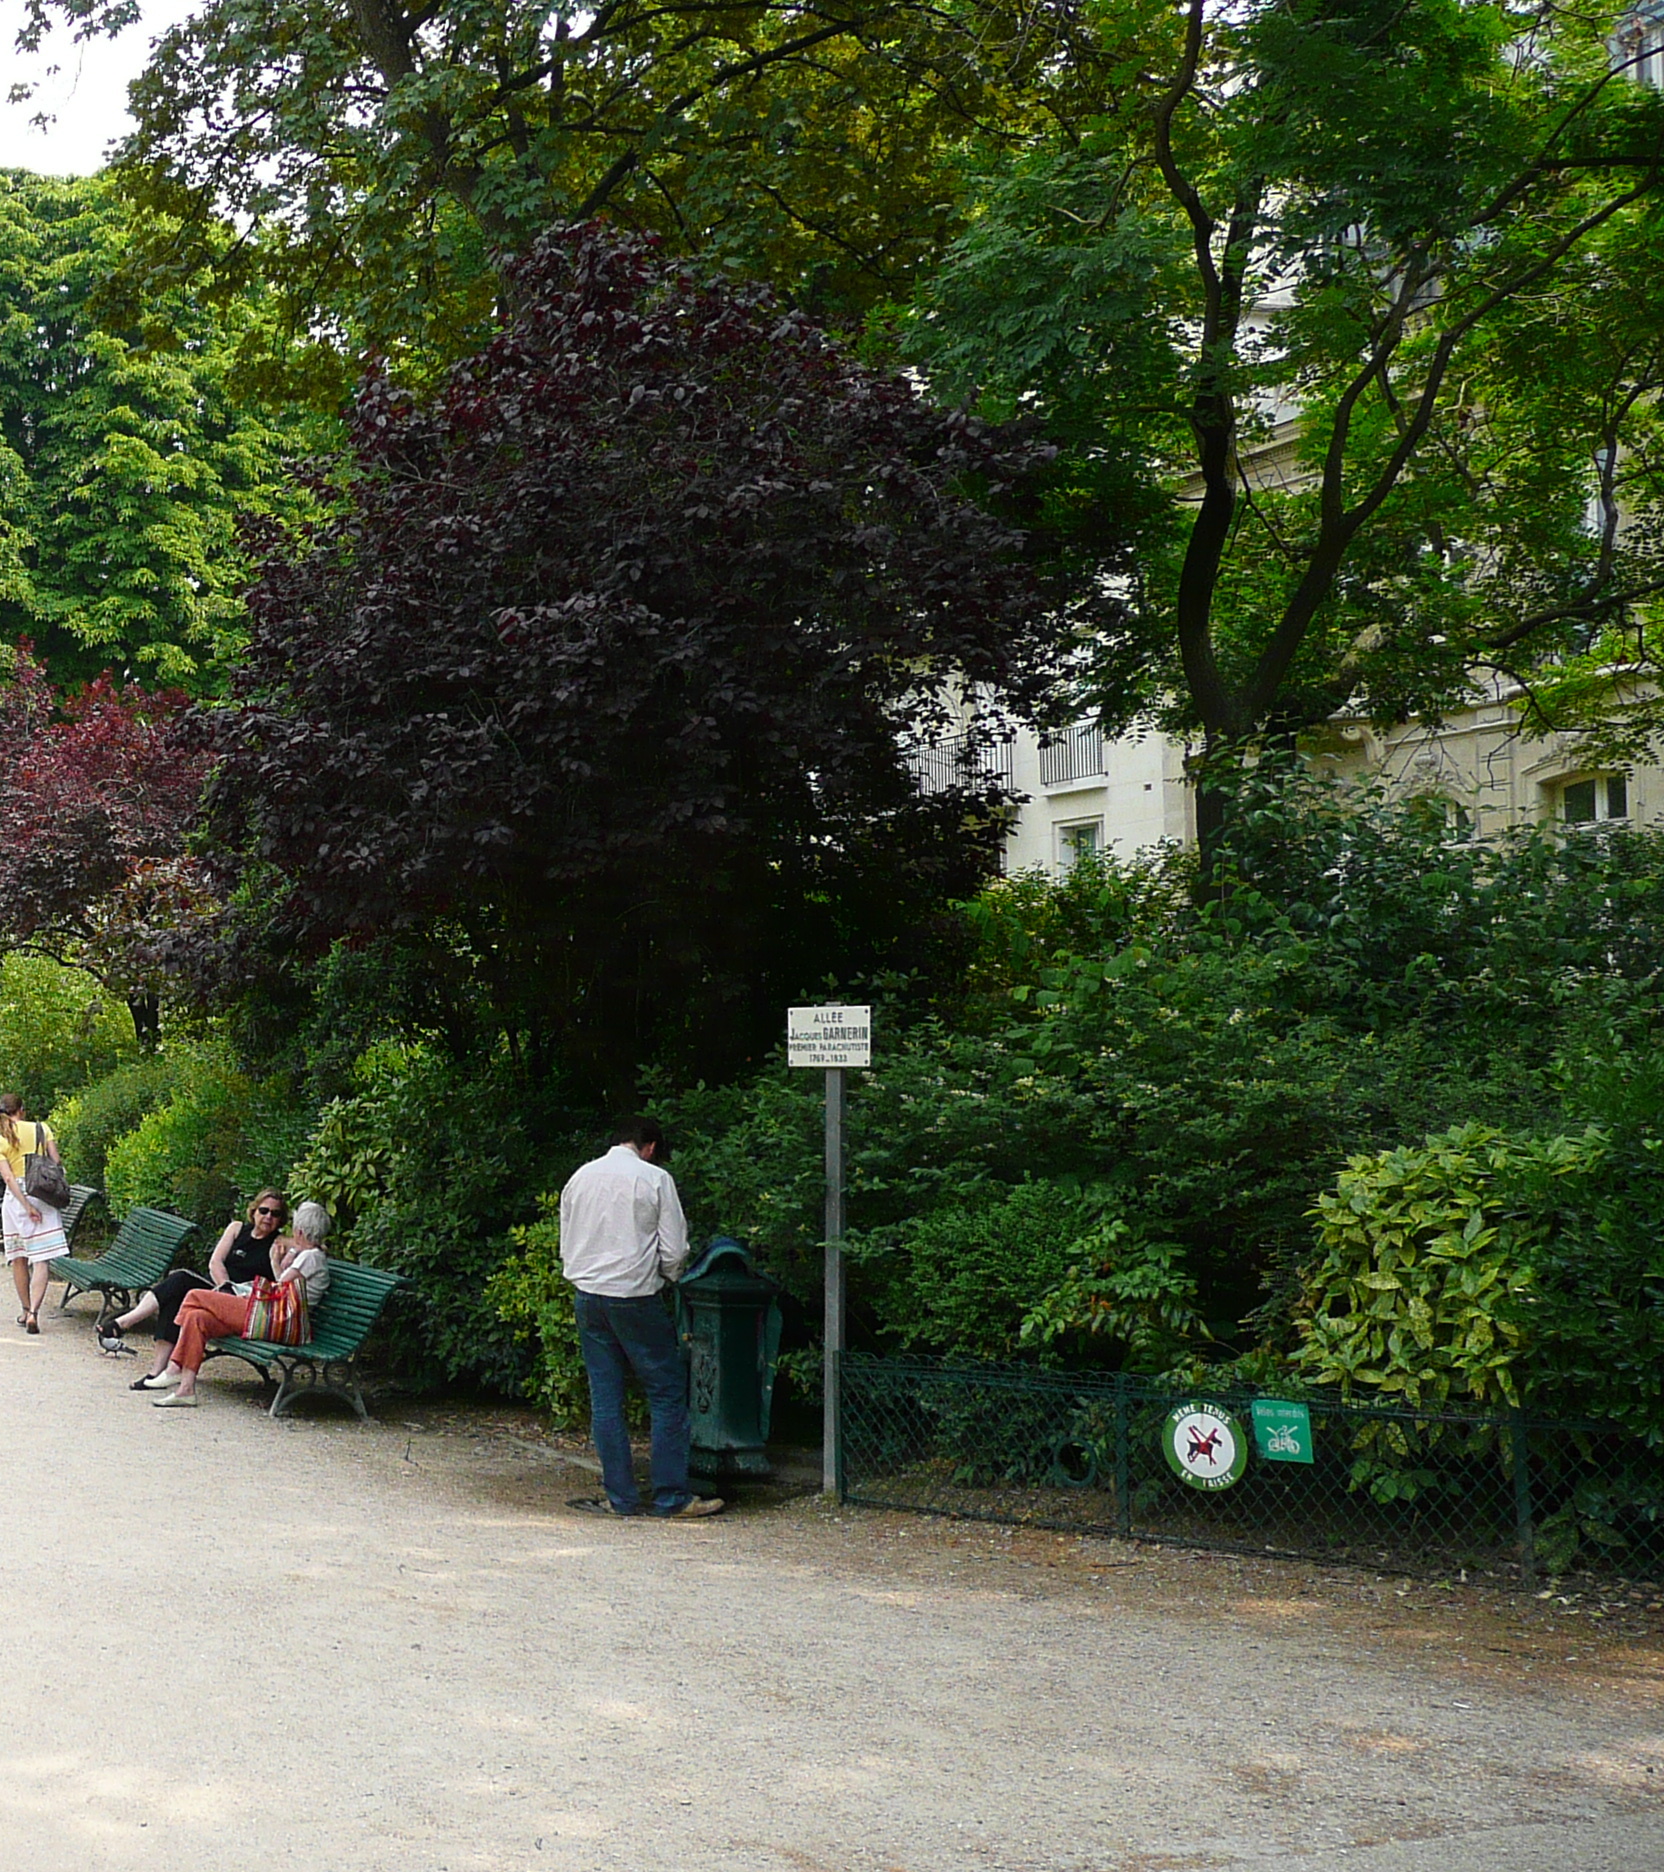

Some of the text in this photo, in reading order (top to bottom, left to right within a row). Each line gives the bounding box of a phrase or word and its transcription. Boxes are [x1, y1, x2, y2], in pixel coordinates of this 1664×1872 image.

[823, 1027, 868, 1040] GARNERIN
[789, 1043, 869, 1052] PREMIER PARACHUTISTE
[1203, 1403, 1231, 1424] TENUS
[1181, 1469, 1193, 1481] EN
